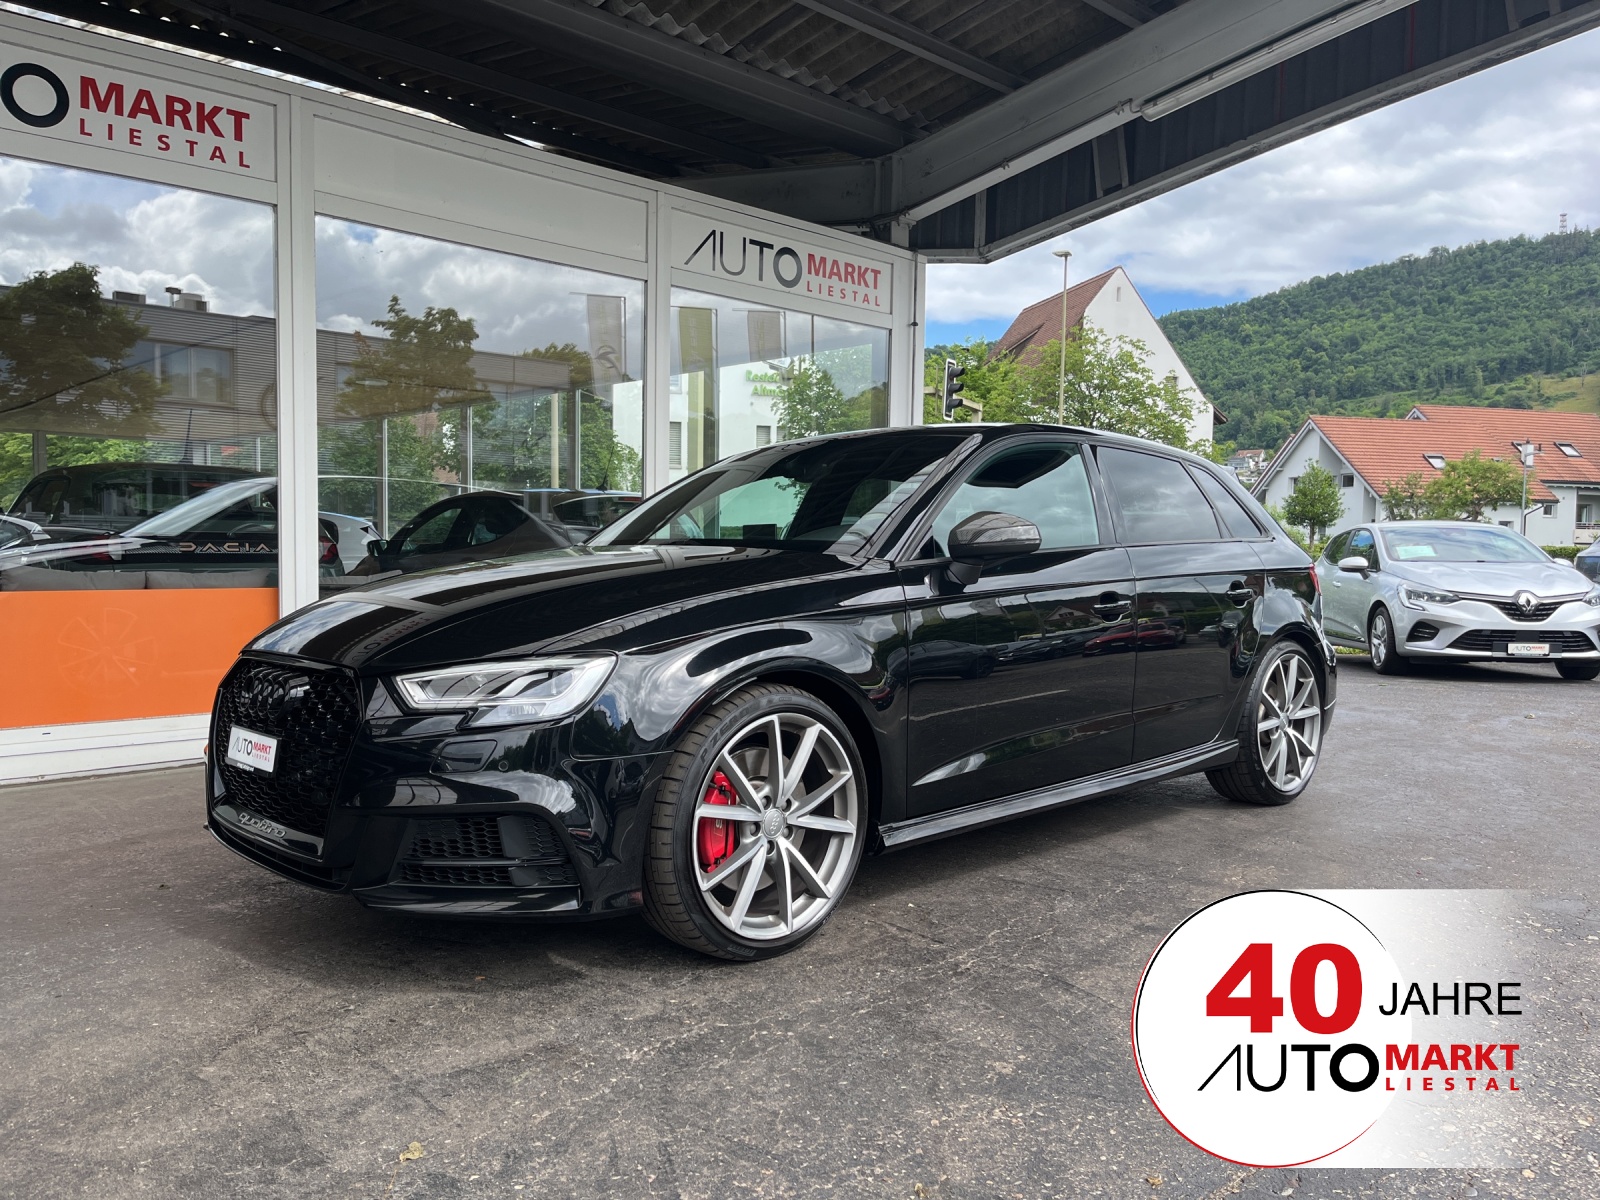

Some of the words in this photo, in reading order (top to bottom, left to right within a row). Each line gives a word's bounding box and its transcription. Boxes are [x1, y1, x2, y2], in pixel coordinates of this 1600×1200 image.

[80, 75, 250, 142] MARKT
[79, 118, 251, 169] LIESTAL
[684, 229, 803, 289] AUTO
[807, 253, 881, 290] MARKT
[806, 281, 880, 306] LIESTAL
[179, 542, 272, 552] DACIA
[232, 736, 253, 756] AUTO
[253, 741, 272, 755] MARKT
[239, 812, 286, 838] quattro
